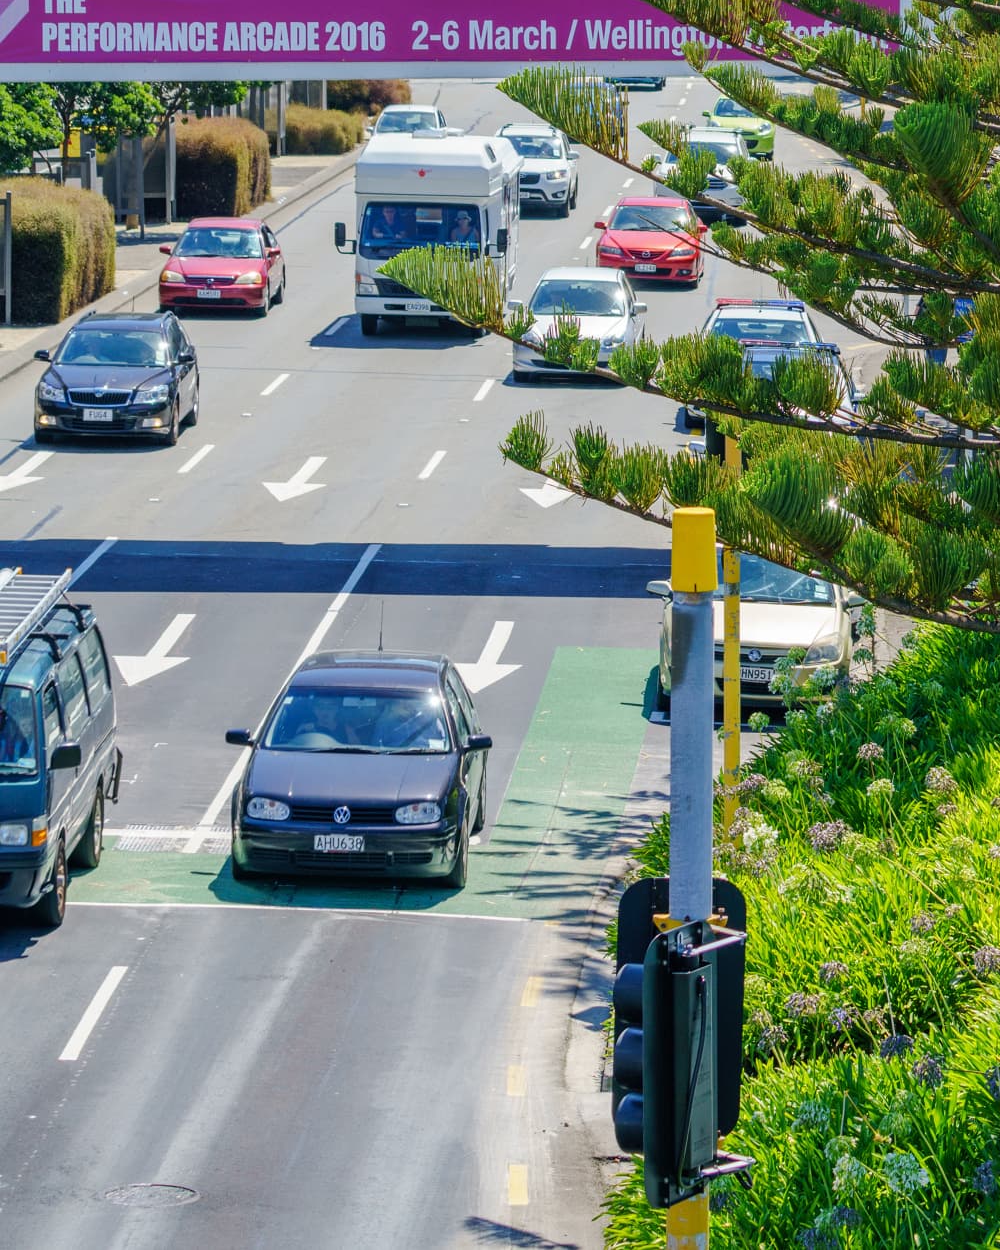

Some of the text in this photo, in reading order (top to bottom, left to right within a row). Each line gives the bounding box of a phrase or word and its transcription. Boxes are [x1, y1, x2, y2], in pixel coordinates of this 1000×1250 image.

[42, 21, 386, 52] PERFORMANCE ARCADE 2016
[411, 20, 460, 50] 2-6
[468, 19, 557, 51] March
[741, 669, 772, 680] HN951
